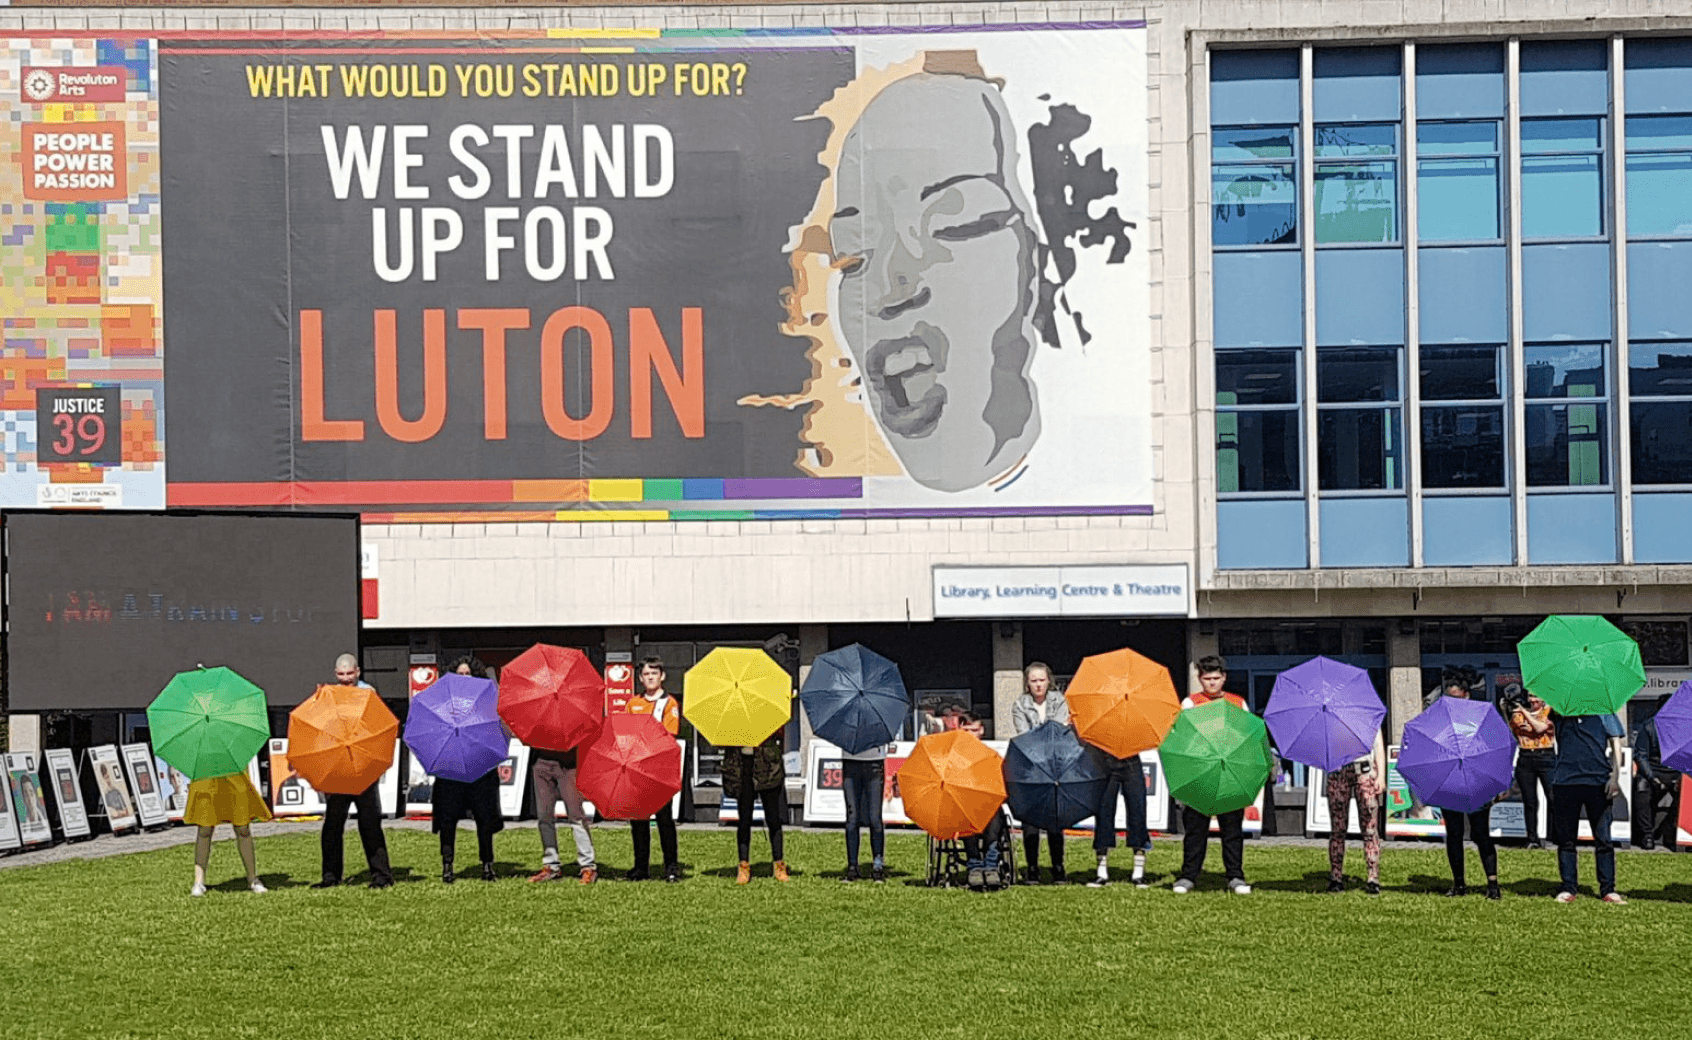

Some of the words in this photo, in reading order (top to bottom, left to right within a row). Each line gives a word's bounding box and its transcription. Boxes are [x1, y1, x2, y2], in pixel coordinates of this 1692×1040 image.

[58, 73, 117, 85] Revoluton
[246, 64, 333, 98] WHAT
[340, 64, 447, 98] WOULD
[455, 63, 515, 97] YOU
[522, 63, 620, 97] STAND
[627, 63, 667, 97] UP
[674, 62, 748, 96] FOR?
[58, 85, 86, 95] Arts
[34, 133, 114, 151] PEOPLE
[34, 153, 114, 171] POWER
[320, 125, 430, 199] WE
[448, 123, 674, 200] STAND
[34, 173, 115, 188] PASSION
[372, 207, 464, 282] UP
[484, 206, 616, 281] FOR
[299, 306, 706, 442] LUTON
[53, 398, 105, 413] JUSTICE
[53, 413, 105, 455] 39
[941, 585, 991, 600] Library,
[996, 583, 1058, 600] Learning
[1062, 583, 1109, 596] Centre
[1112, 583, 1123, 595] &
[1127, 582, 1182, 596] Theatre
[823, 769, 843, 788] 39
